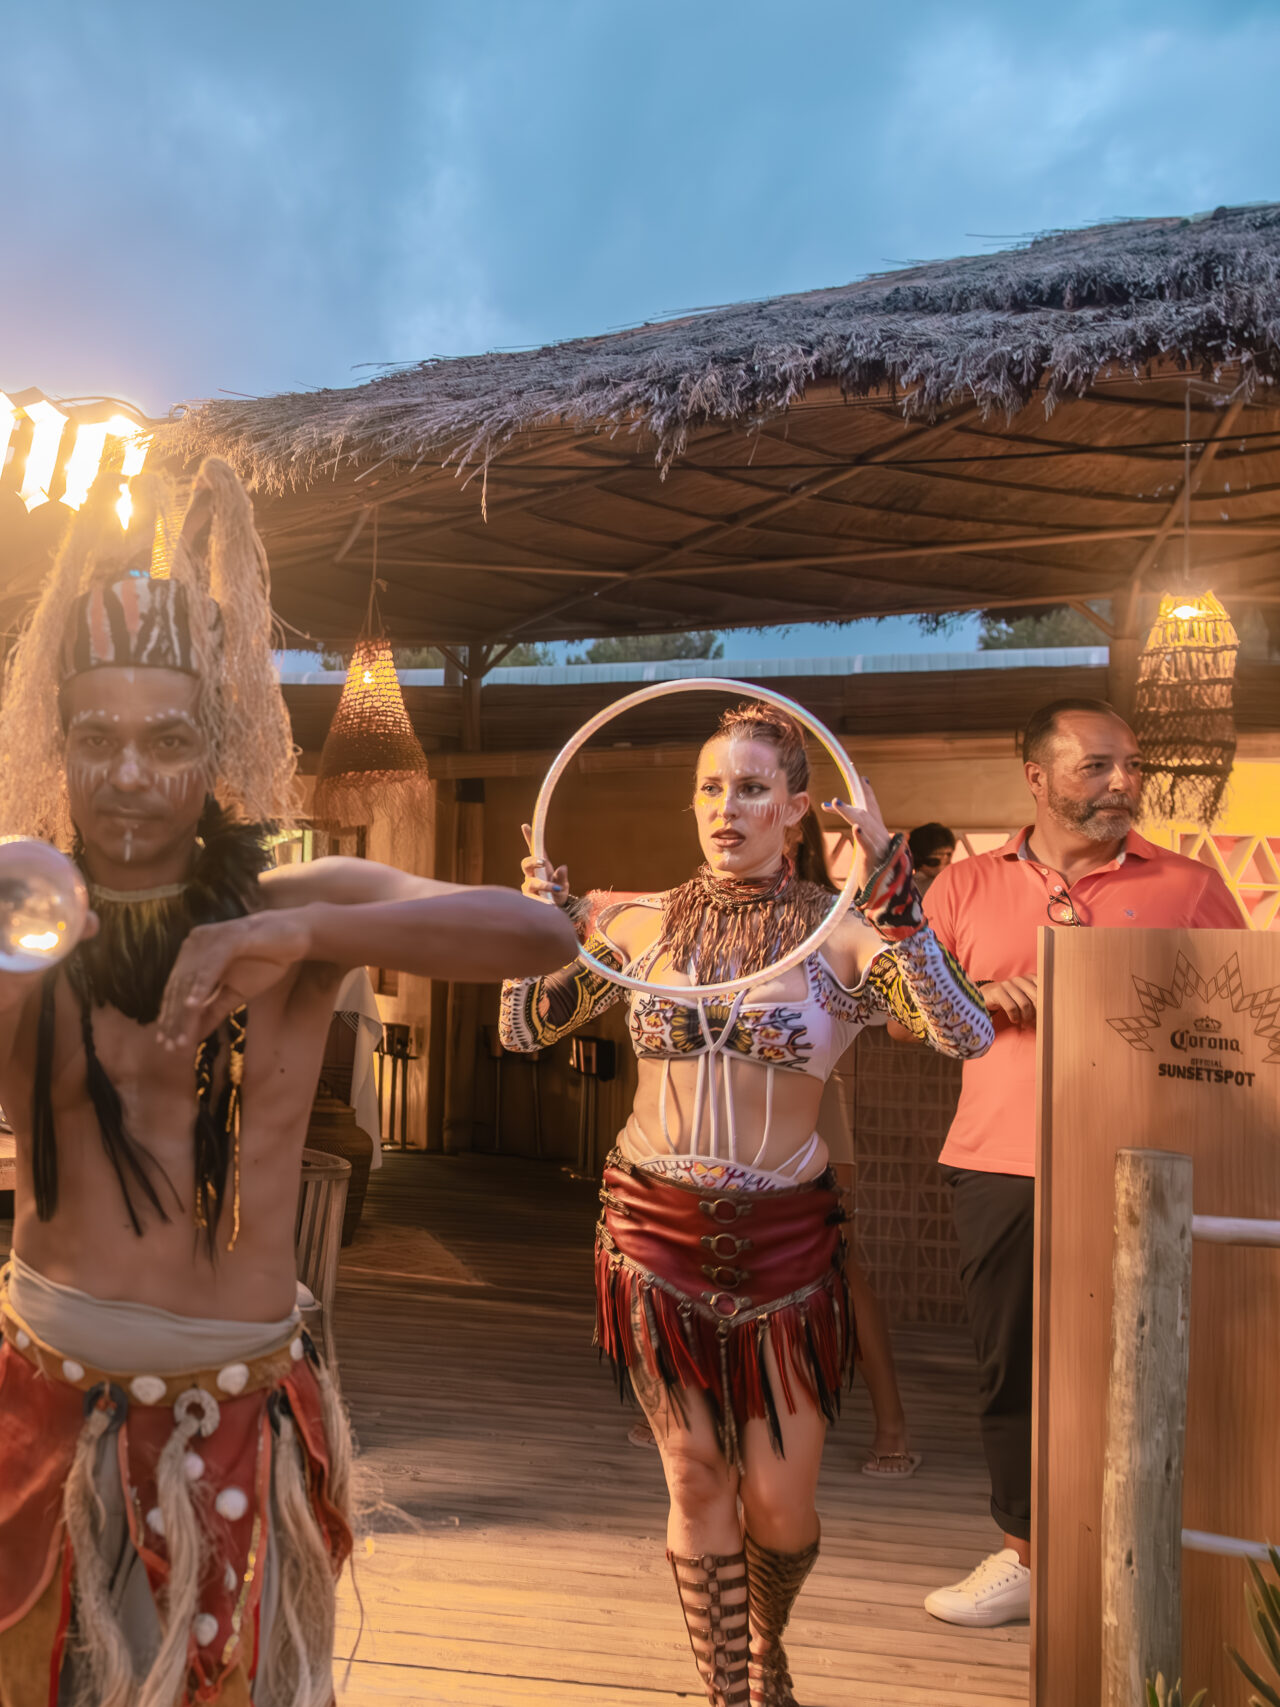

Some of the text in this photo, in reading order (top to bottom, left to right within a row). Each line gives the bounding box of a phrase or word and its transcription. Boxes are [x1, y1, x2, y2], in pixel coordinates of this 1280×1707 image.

[1170, 1029, 1241, 1053] Corona
[1190, 1057, 1224, 1068] OFFICIAL
[1158, 1063, 1256, 1088] SUNSETSPOT
